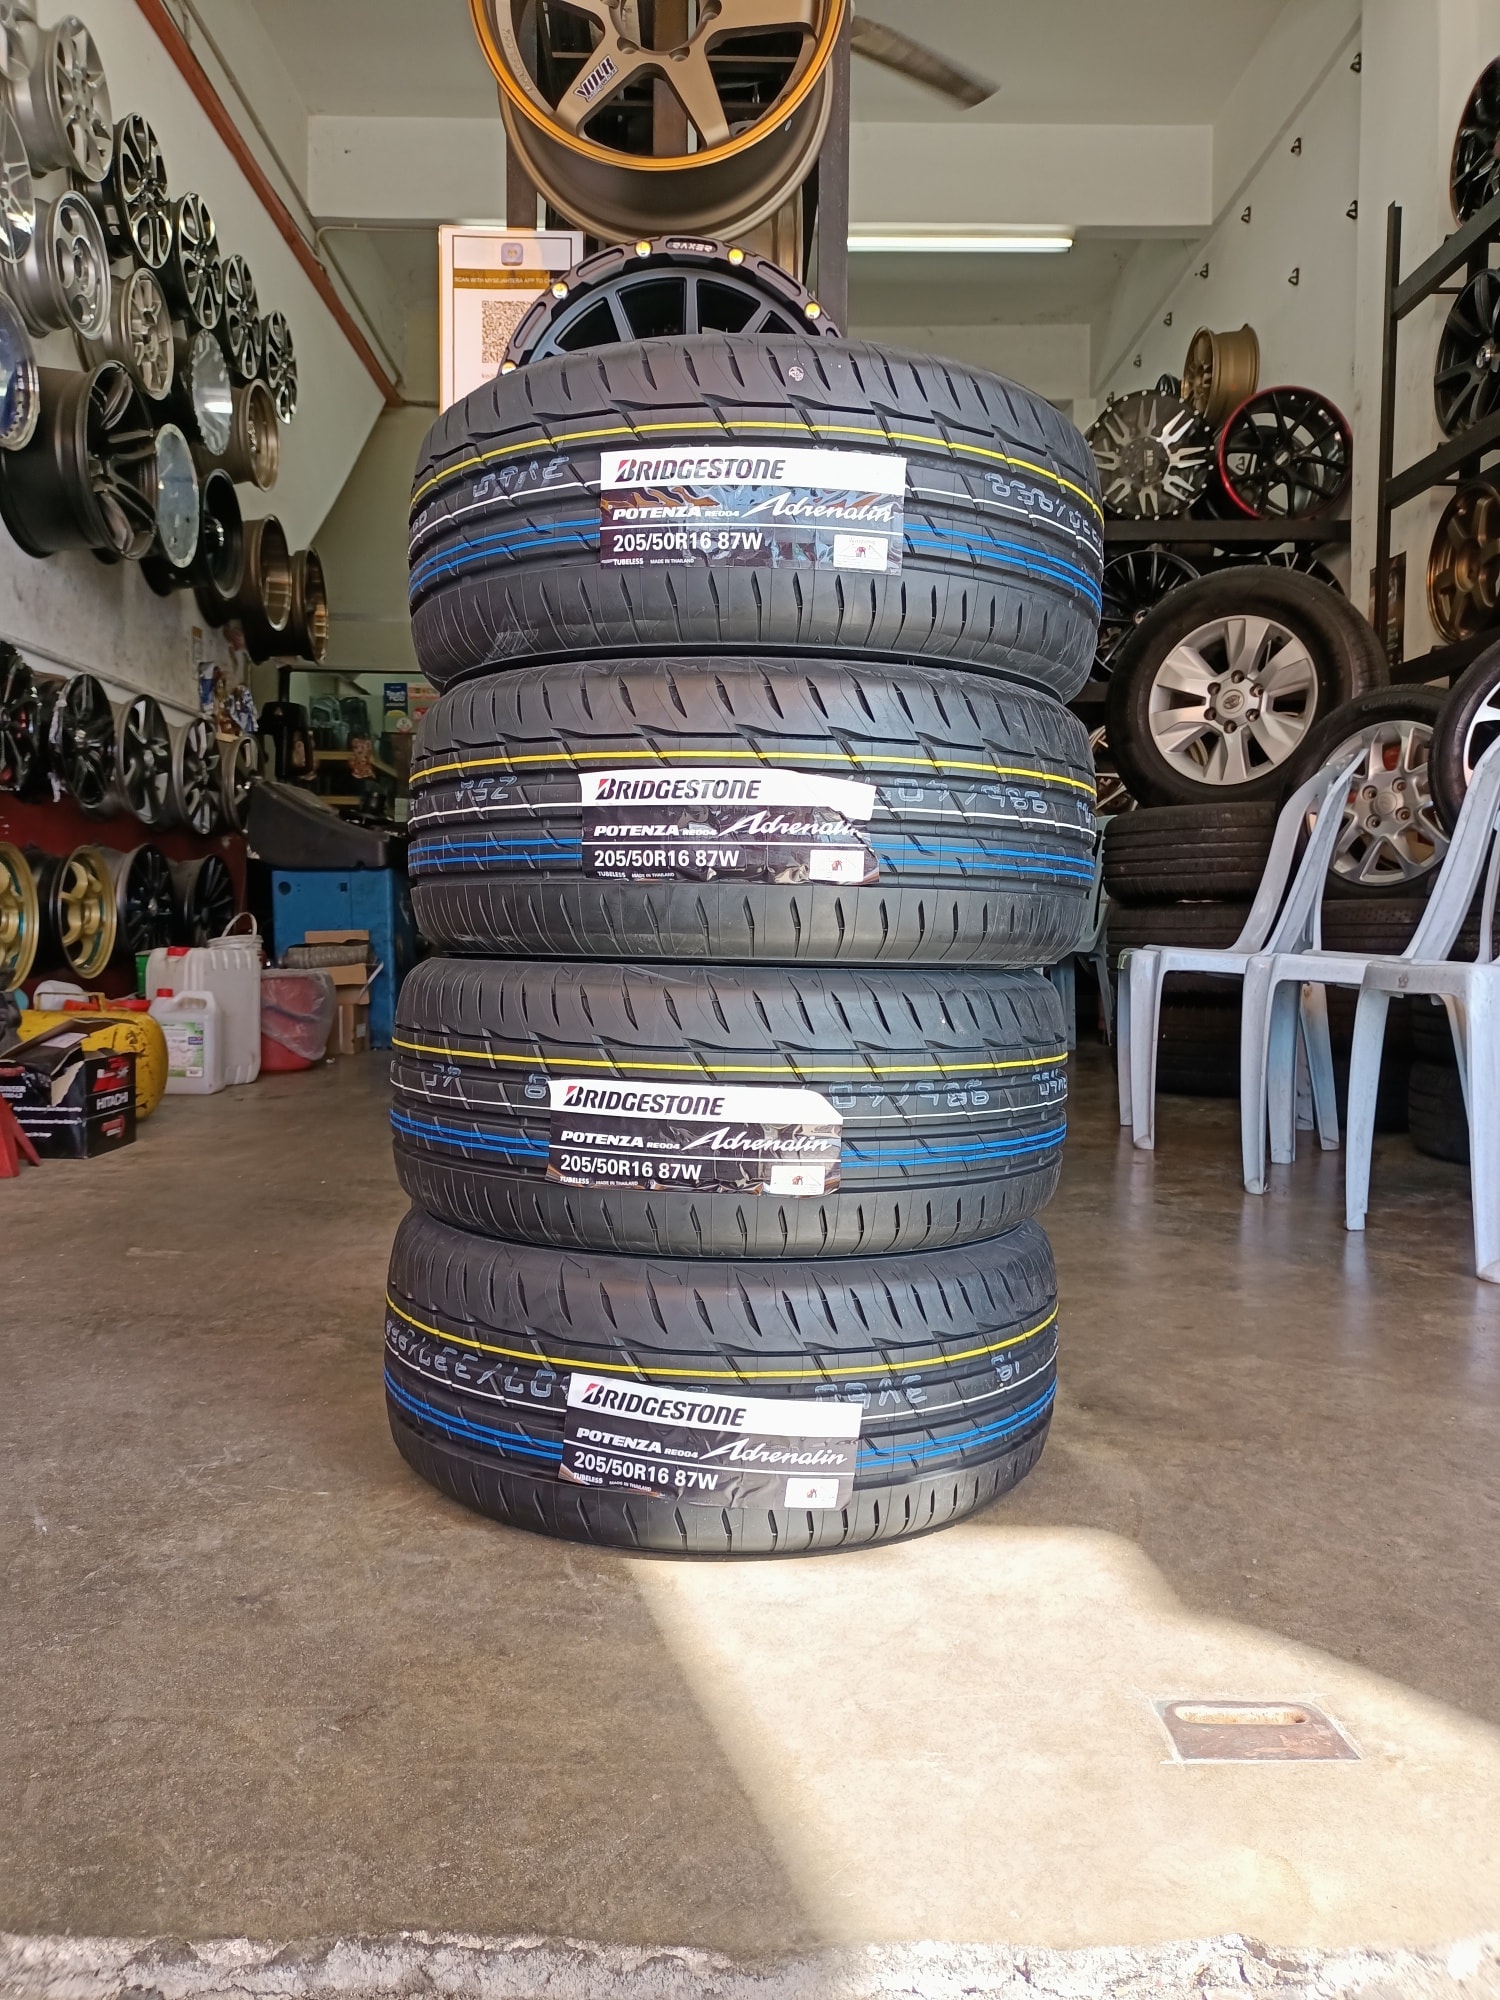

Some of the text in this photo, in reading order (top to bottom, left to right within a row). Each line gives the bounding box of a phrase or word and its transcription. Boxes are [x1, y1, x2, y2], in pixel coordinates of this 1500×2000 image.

[615, 459, 786, 482] BRIDGESTONE
[613, 491, 895, 522] POTENZA RE004 Adrenalin
[613, 532, 763, 552] 205/50R16 87W
[613, 558, 644, 566] TUBELESS
[595, 778, 762, 800] BRIDGESTONE
[594, 825, 679, 837] POTENZA
[594, 850, 740, 867] 205/50R16 87W
[97, 1092, 128, 1110] HITACHI
[564, 1085, 725, 1116] BRIDGESTONE
[561, 1127, 832, 1151] POTENZA RE004 Adrenalin
[560, 1155, 702, 1181] 205/50R16 87W
[559, 1176, 590, 1185] TUBELESS
[581, 1383, 747, 1427] BRIDGESTONE
[576, 1427, 848, 1465] POTENZA RE004 Adrenalin
[572, 1472, 604, 1484] TUBELESS
[574, 1451, 718, 1490] 205/50R16 87W
